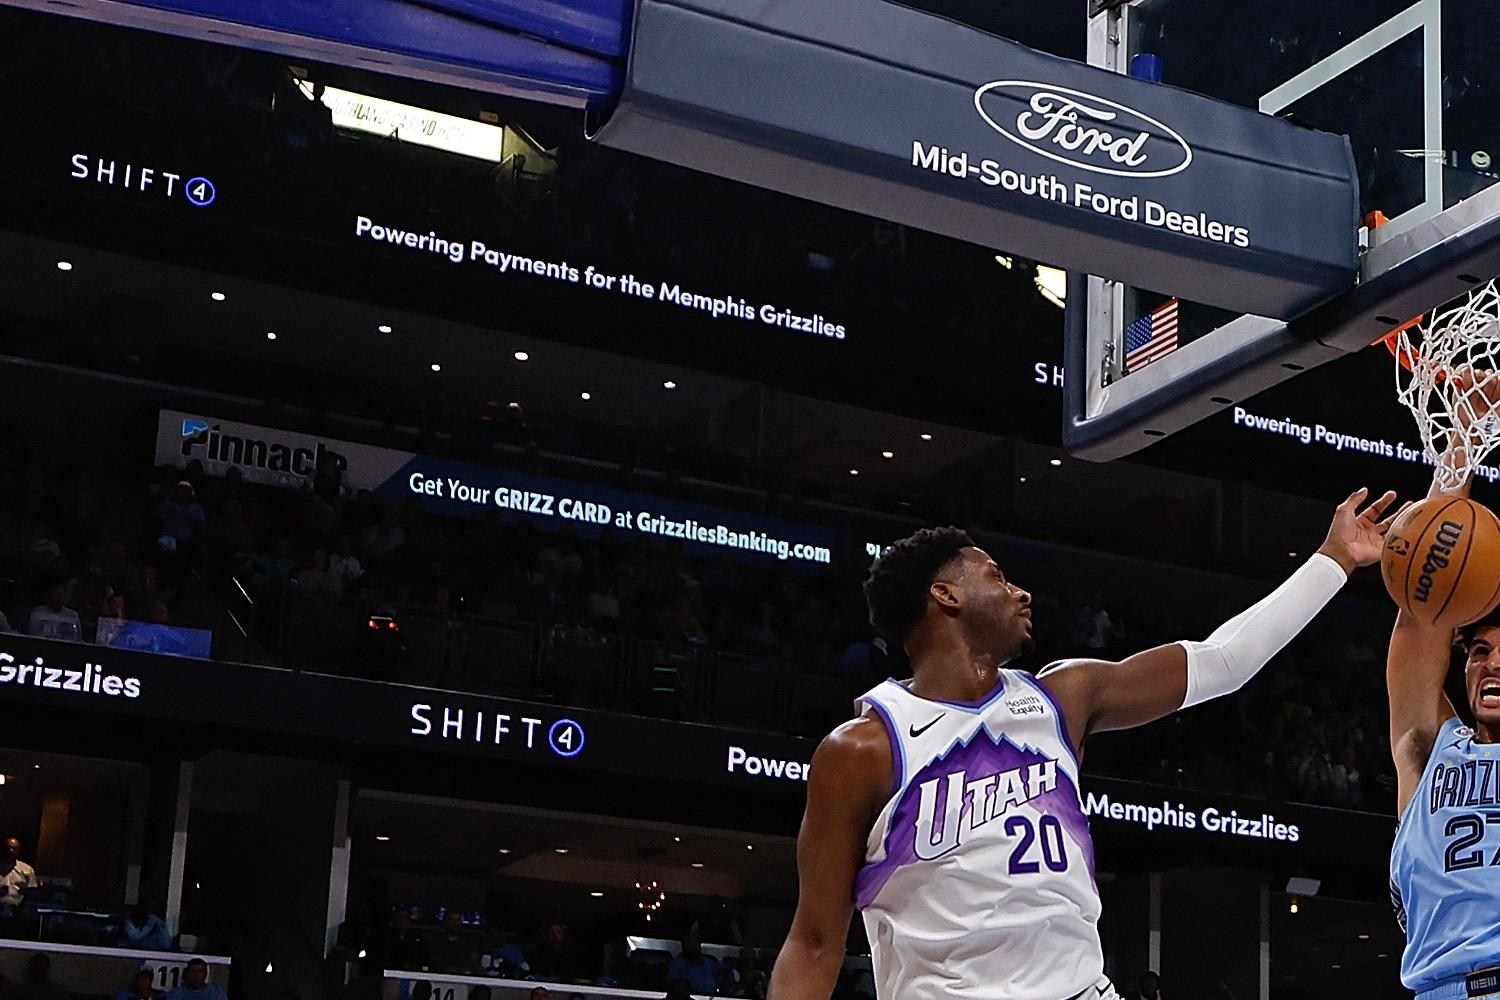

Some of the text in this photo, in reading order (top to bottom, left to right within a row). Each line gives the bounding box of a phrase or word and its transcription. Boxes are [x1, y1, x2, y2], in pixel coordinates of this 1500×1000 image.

[1017, 92, 1150, 166] Ford
[911, 140, 1250, 248] Mid-South Ford Dealers
[355, 215, 847, 340] Powering Payments for the Memphis Grizzlies
[1233, 406, 1311, 444] Powering
[1314, 424, 1394, 458] Payments
[1396, 442, 1419, 463] for
[408, 472, 831, 564] Get Your GRIZZ CARD at GrizzliesBanking.com
[1413, 520, 1464, 603] Wilson
[0, 652, 141, 698] Grizzlies
[1009, 702, 1045, 717] Equity
[1004, 813, 1070, 875] 20
[1086, 793, 1196, 830] Memphis
[1201, 808, 1300, 842] Grizzlies
